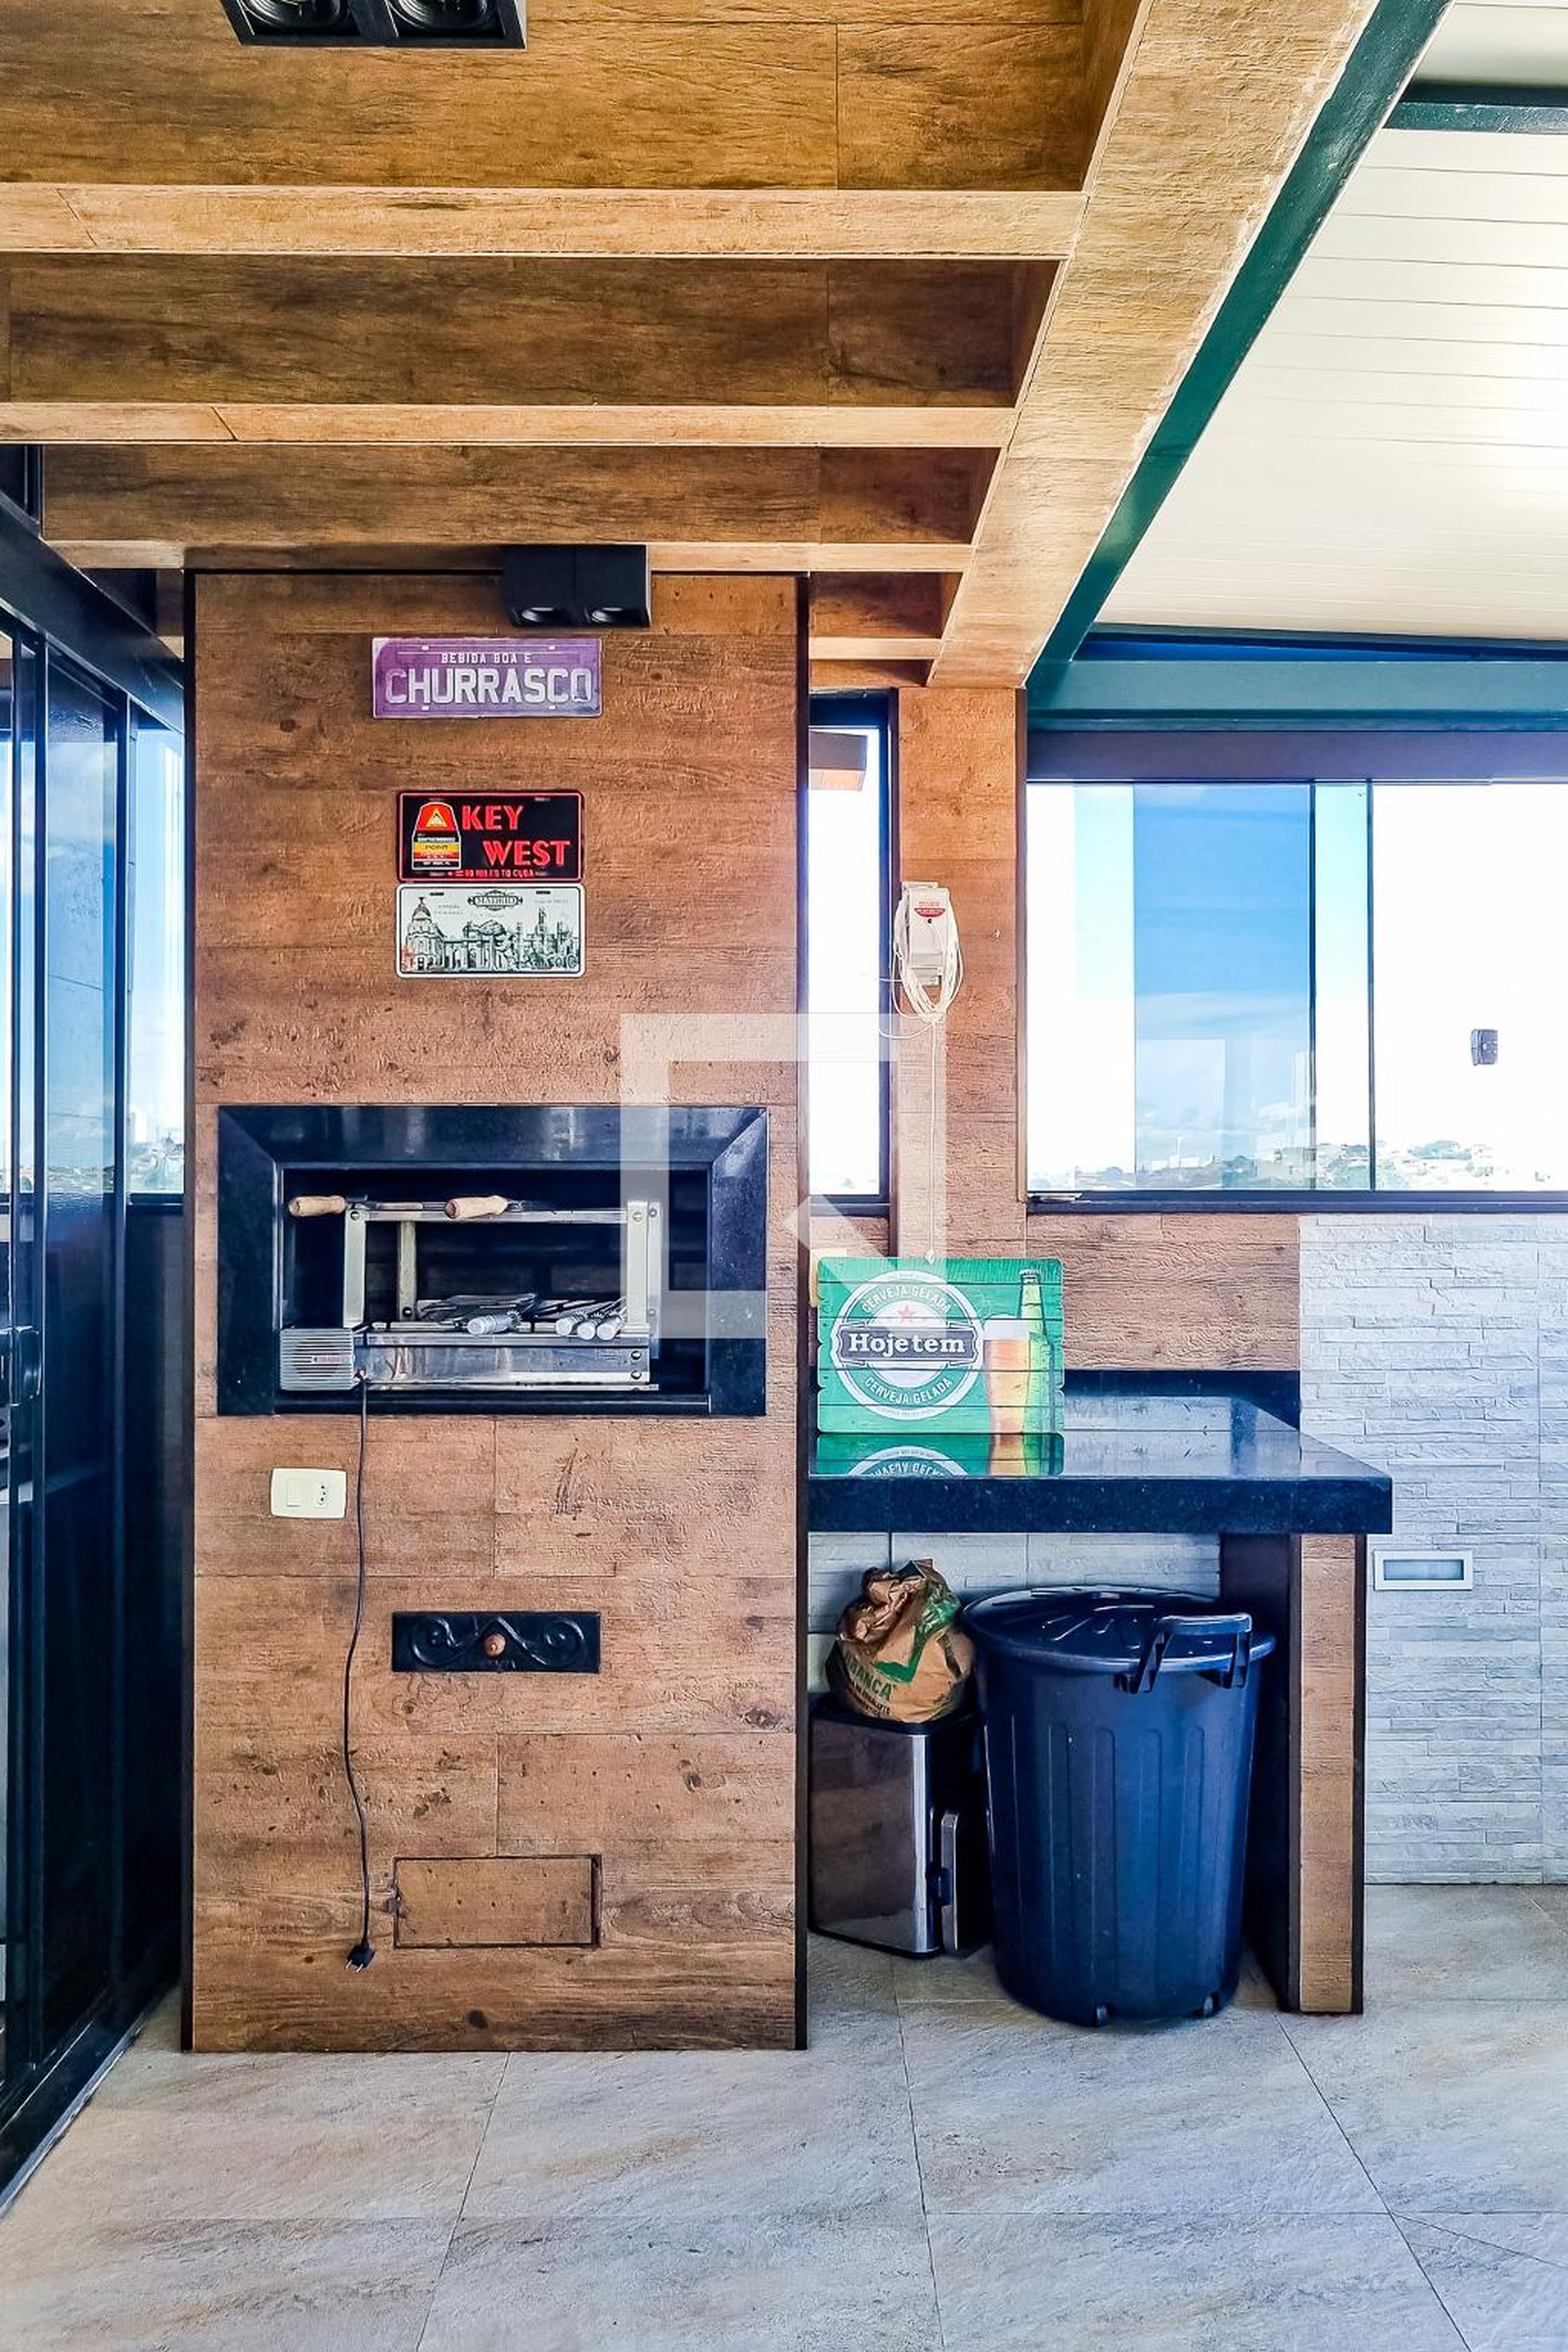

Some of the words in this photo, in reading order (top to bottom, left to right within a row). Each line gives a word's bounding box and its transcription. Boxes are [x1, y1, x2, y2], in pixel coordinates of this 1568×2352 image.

[441, 653, 486, 664] BEBIDA
[494, 653, 517, 664] BOA
[385, 668, 592, 704] CHURRASCO
[461, 805, 523, 831] KEY
[483, 840, 571, 866] WEST
[862, 1285, 909, 1313] CERVEJA
[912, 1286, 952, 1313] GELADA
[864, 1377, 909, 1404] CERVEJA
[913, 1377, 953, 1403] GELADA
